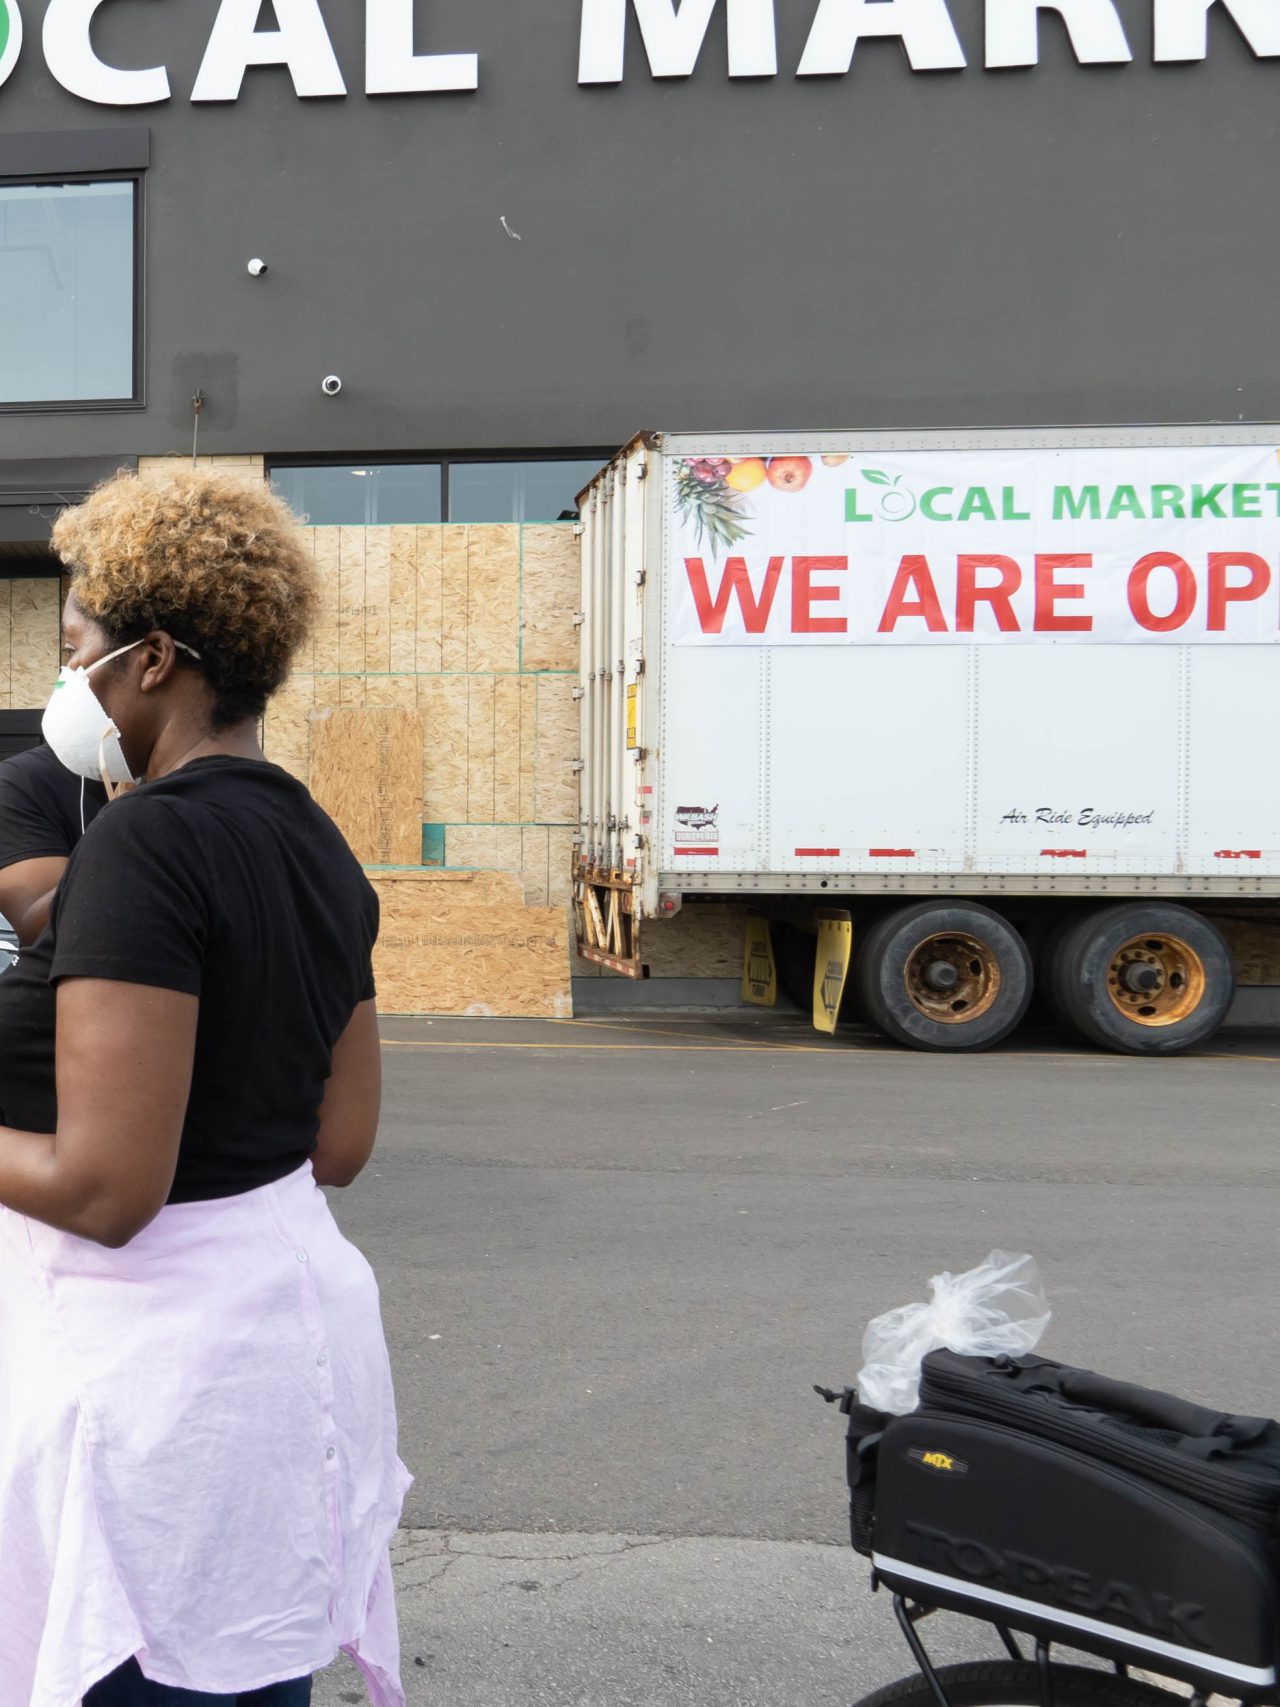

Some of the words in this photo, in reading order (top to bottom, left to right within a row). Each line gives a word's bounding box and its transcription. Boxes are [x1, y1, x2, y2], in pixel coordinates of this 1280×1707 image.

[844, 485, 1030, 522] LOCAL
[684, 555, 848, 634] WE
[877, 553, 1093, 633] ARE
[1127, 551, 1280, 632] OP
[999, 807, 1029, 824] Air
[1035, 807, 1072, 824] Ride
[1077, 807, 1155, 828] Equipped
